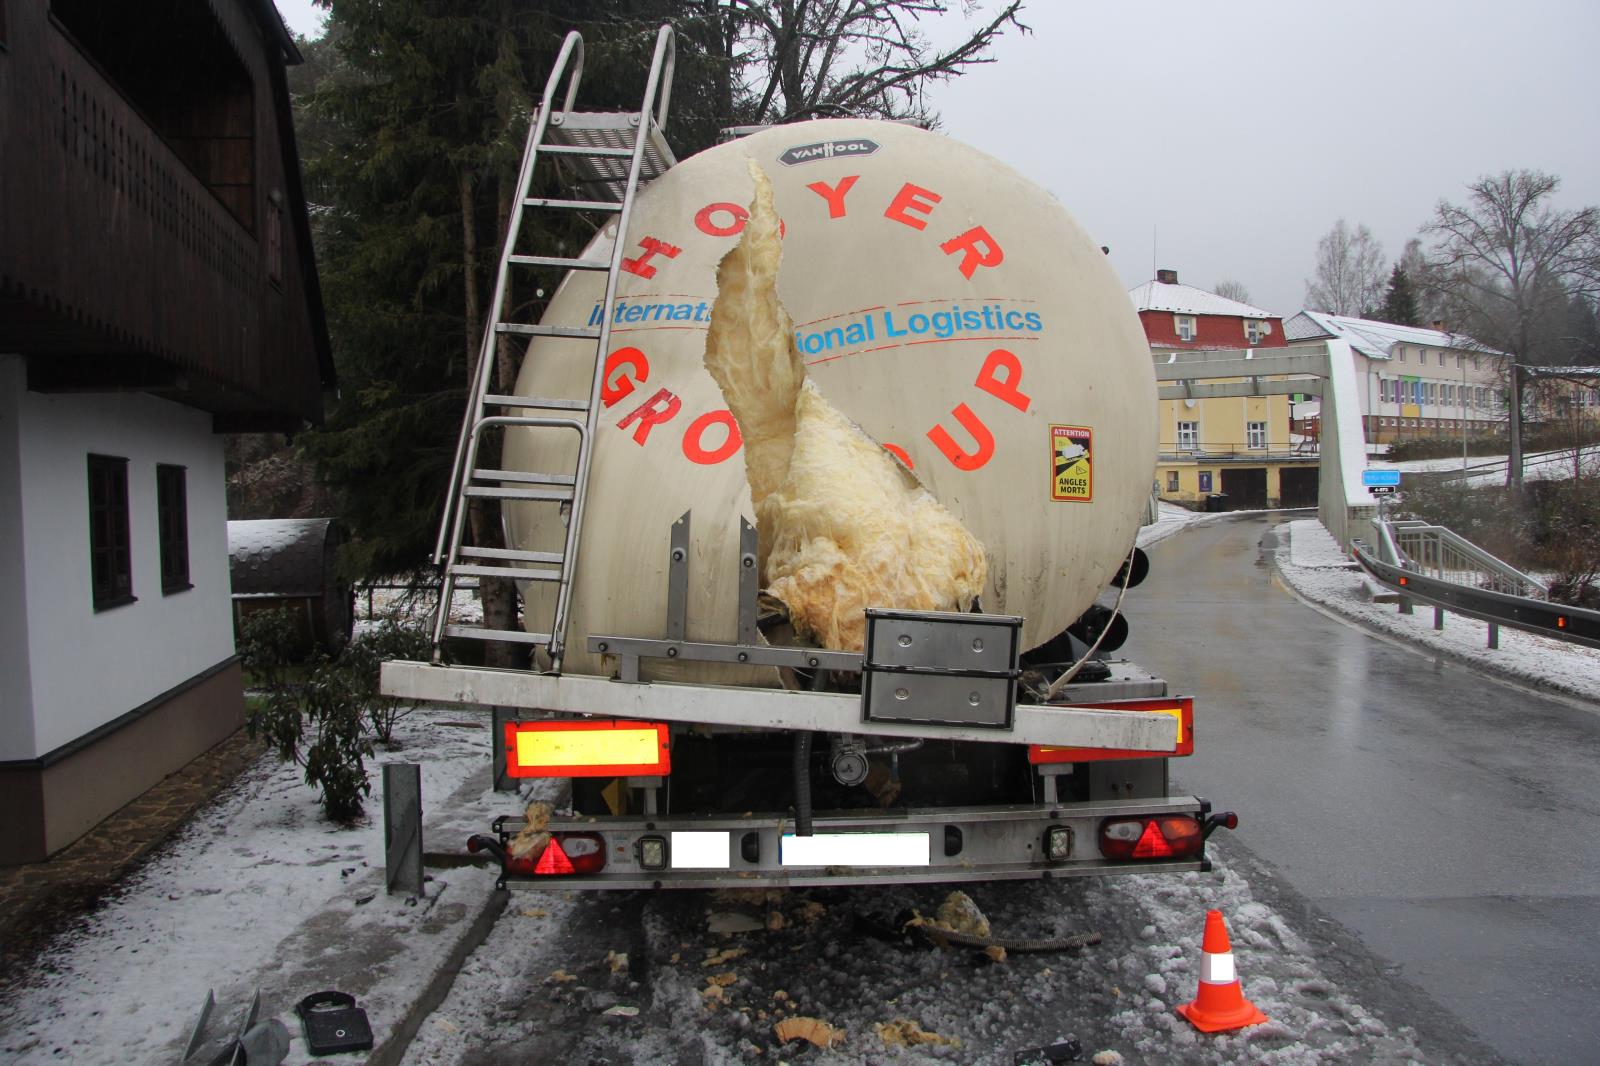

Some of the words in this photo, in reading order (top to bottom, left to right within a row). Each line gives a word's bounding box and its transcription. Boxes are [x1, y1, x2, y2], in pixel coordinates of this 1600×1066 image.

[792, 142, 868, 159] VANHOOL
[620, 175, 1004, 281] HOYER
[884, 305, 1043, 338] Logistics
[1054, 429, 1090, 437] ATTENTION
[1059, 478, 1087, 486] ANGLES
[1060, 486, 1086, 494] MORTS
